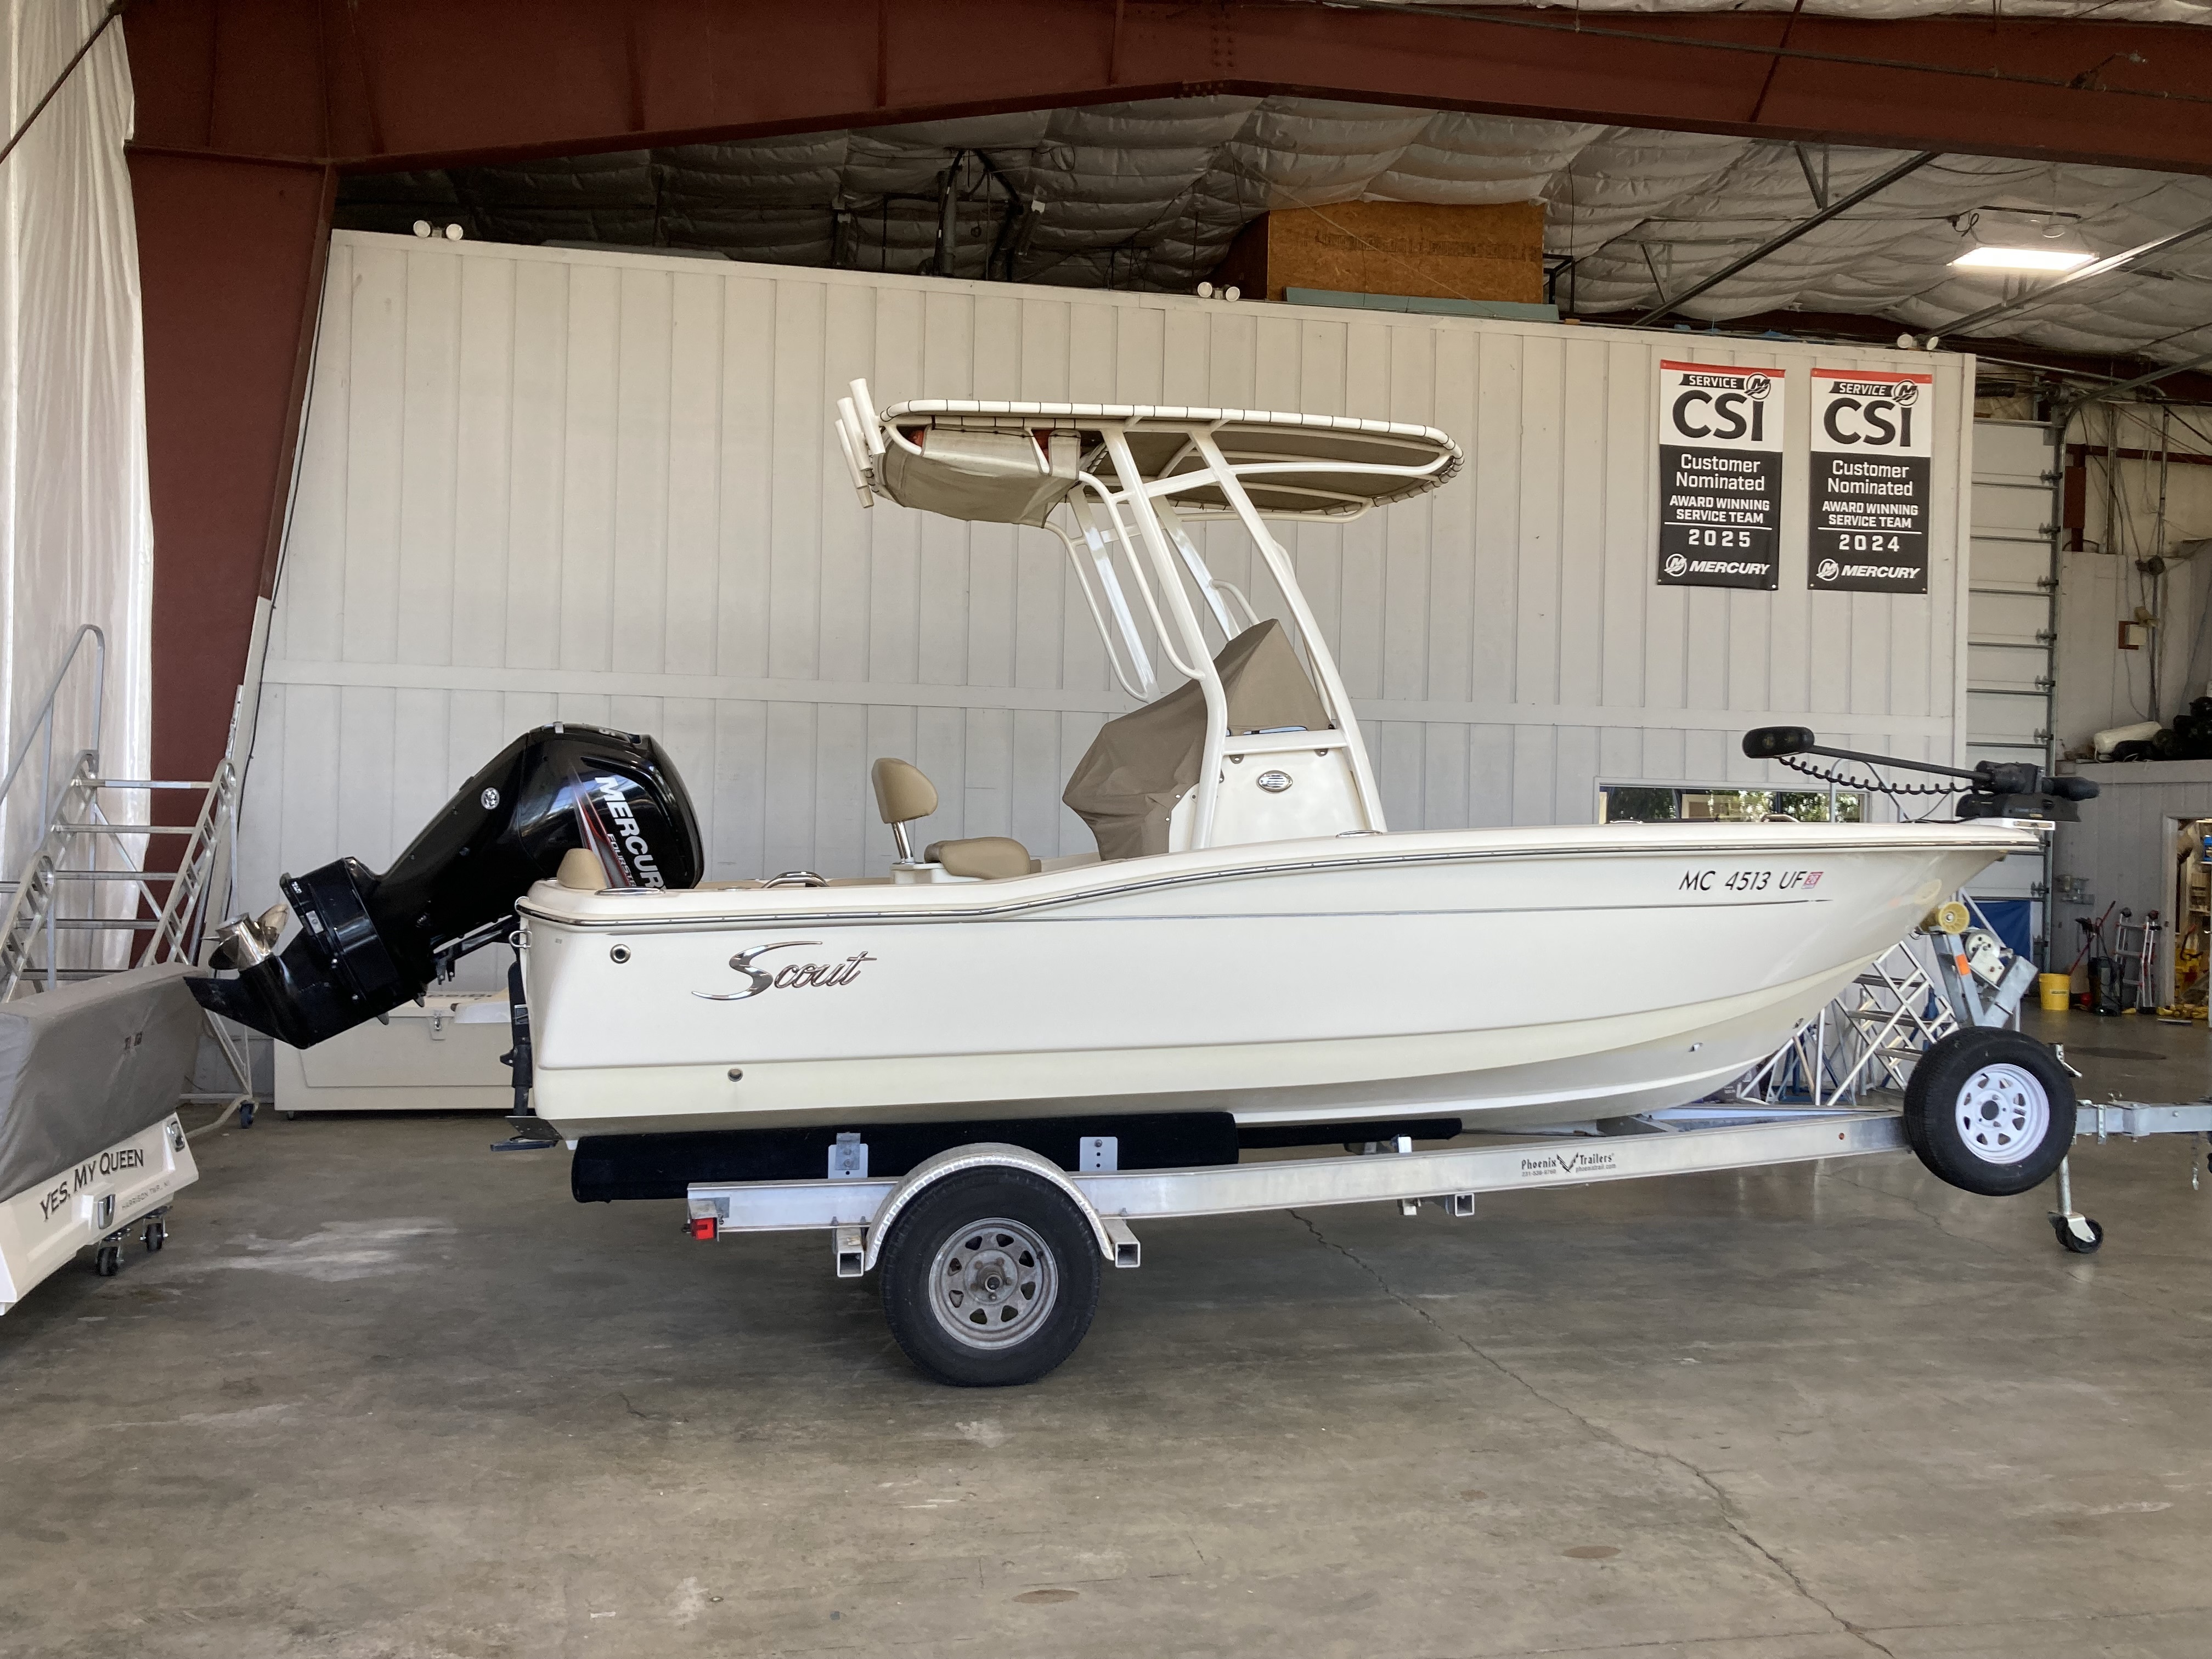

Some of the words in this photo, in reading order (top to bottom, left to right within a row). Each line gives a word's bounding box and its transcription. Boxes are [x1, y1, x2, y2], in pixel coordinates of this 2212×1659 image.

[1689, 376, 1737, 388] SERVICE
[1839, 383, 1887, 396] SERVICE
[1681, 454, 1760, 473] Customer
[1832, 460, 1909, 478] Customer
[1676, 471, 1765, 491] Nominated
[1827, 478, 1913, 496] Nominated
[1669, 495, 1714, 508] AWARD
[1716, 498, 1770, 511] WINNING
[1822, 501, 1864, 513] AWARD
[1866, 503, 1918, 516] WINNING
[1676, 509, 1728, 522] SERVICE
[1730, 512, 1763, 523] TEAM
[1829, 514, 1877, 527] SERVICE
[1880, 517, 1912, 528] TEAM
[1688, 529, 1751, 548] 2025
[1839, 534, 1899, 552] 2024
[1689, 561, 1771, 575] MERCURY
[1841, 565, 1921, 579] MERCURY
[595, 777, 667, 889] MERCUR
[607, 833, 637, 887] FOURSTR
[1678, 870, 1717, 891] MC
[1724, 871, 1771, 891] 4513
[1779, 871, 1808, 889] UF
[691, 940, 877, 1001] Scout
[1521, 1157, 1556, 1170] Phoenix
[40, 1180, 71, 1222] YES,
[73, 1160, 96, 1194] MY
[99, 1149, 144, 1176] QUEEN
